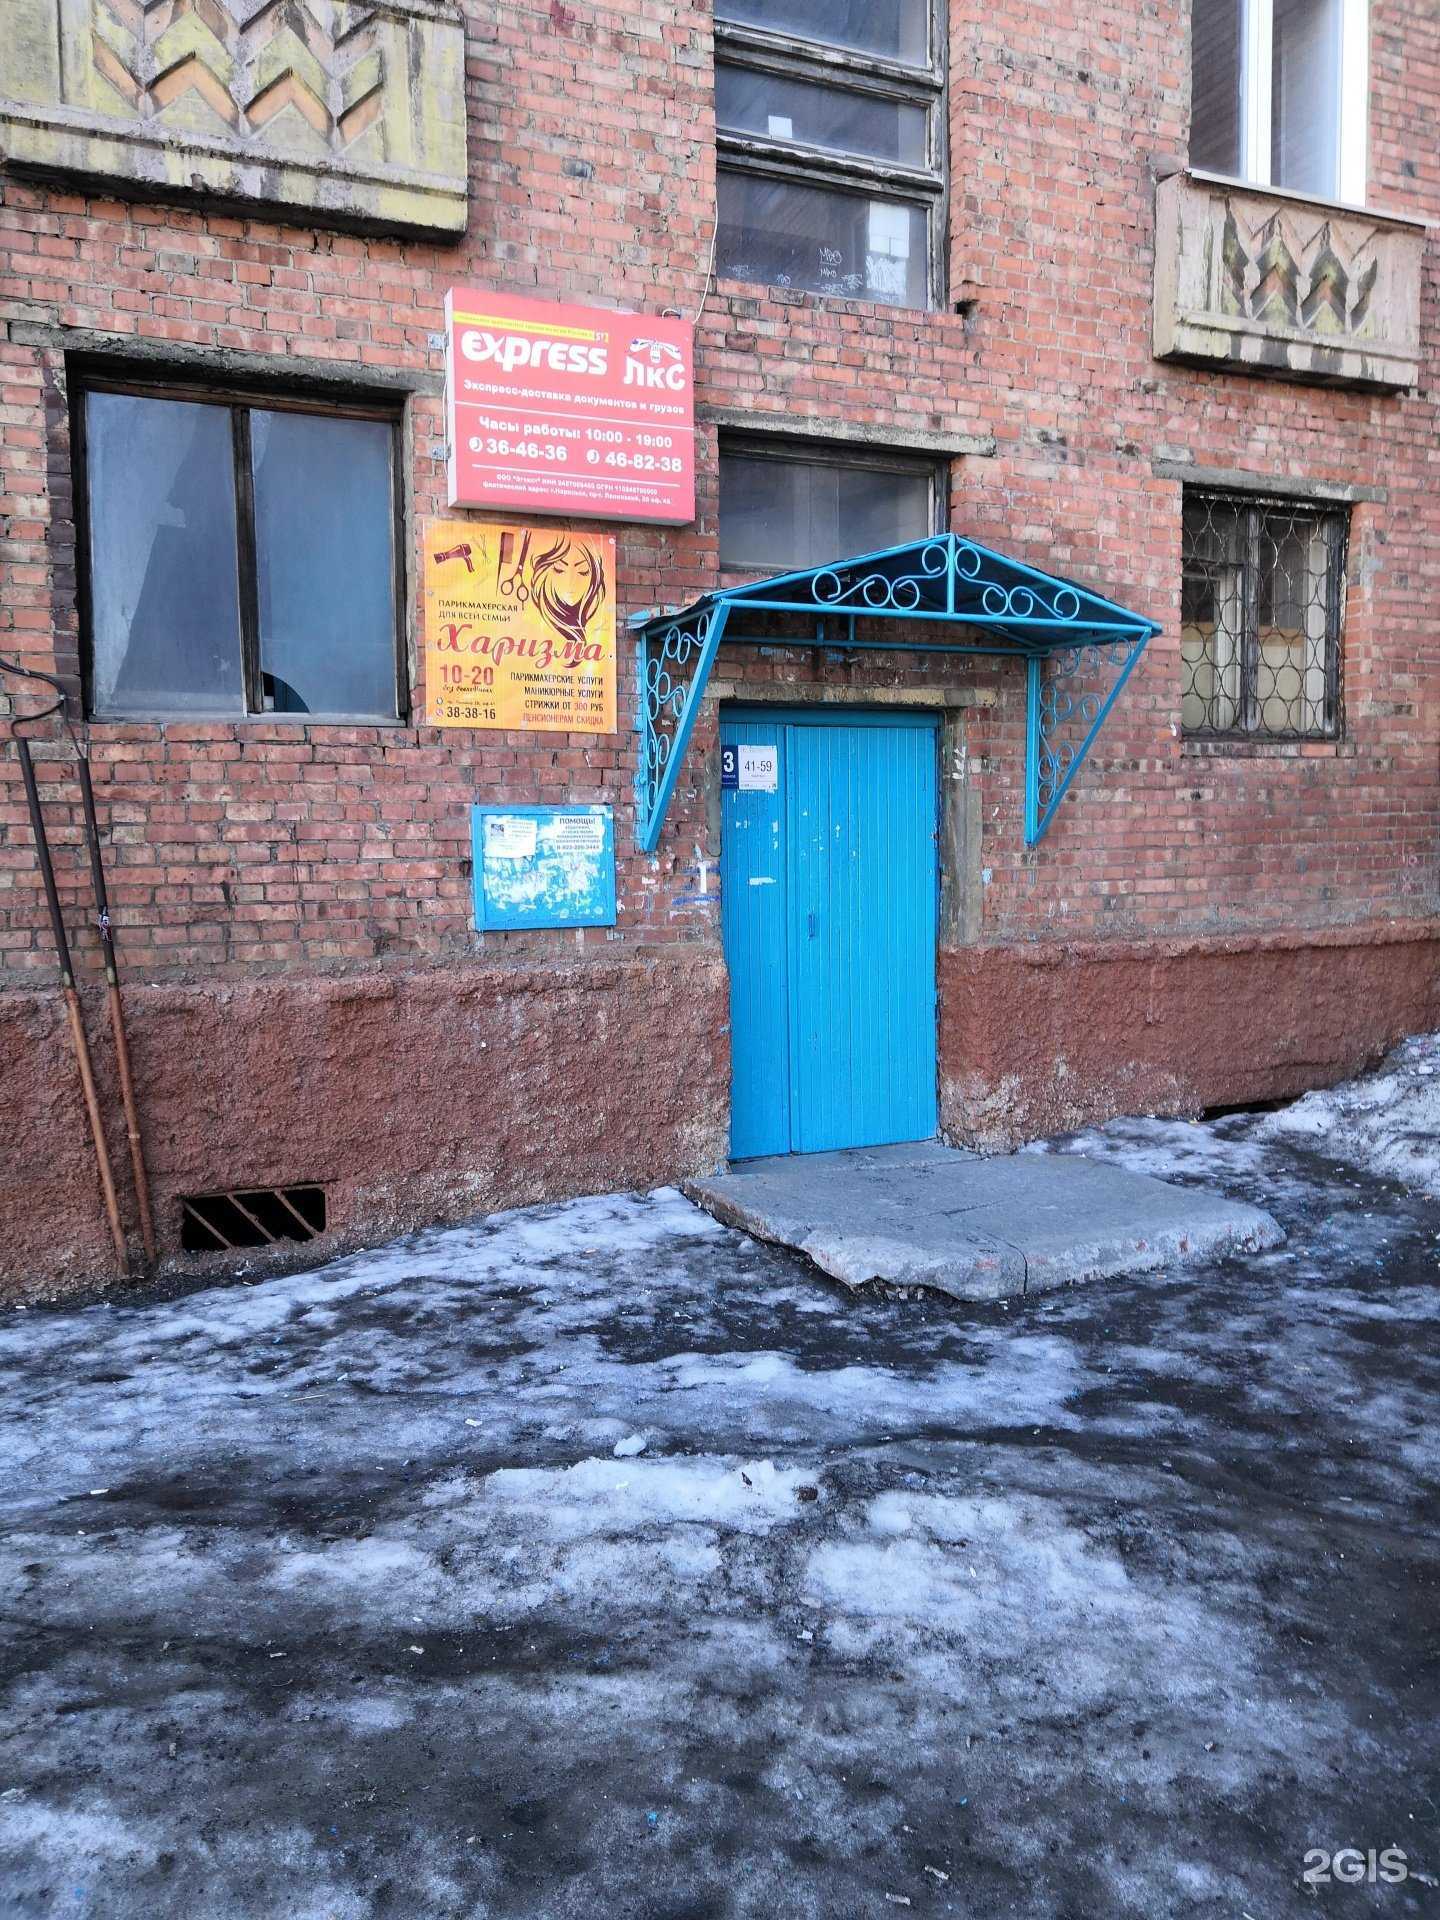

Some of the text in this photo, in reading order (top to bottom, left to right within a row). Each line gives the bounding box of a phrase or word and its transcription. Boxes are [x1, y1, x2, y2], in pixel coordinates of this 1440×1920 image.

[463, 379, 684, 414] Экспресс-доставка документов и грузов
[479, 416, 520, 432] Часы
[523, 423, 580, 439] работы:
[586, 428, 623, 444] 10:00
[636, 433, 673, 448] 19:00
[486, 438, 567, 461] 36-46-36
[605, 451, 682, 473] 46-82-38
[438, 600, 518, 612] ПАРИКМАХЕРСКАЯ
[438, 611, 511, 622] ДЛЯ ВСЕЙ СЕМЬИ
[437, 624, 606, 669] Харизма
[439, 663, 494, 686] 10-20
[510, 672, 603, 686] ПАРИКМАХЕРСКИЕ УСЛУГИ
[524, 686, 604, 699] МАНИКЮРНЫЕ УСЛУГИ
[447, 706, 496, 720] 38-38-16
[525, 700, 560, 710] СТРИЖКИ
[562, 701, 571, 710] ОТ
[590, 702, 604, 712] РУБ
[524, 712, 603, 726] ПЕНСИОНЕРАМ СКИДКА
[723, 751, 735, 773] 3
[744, 760, 772, 773] 41-59
